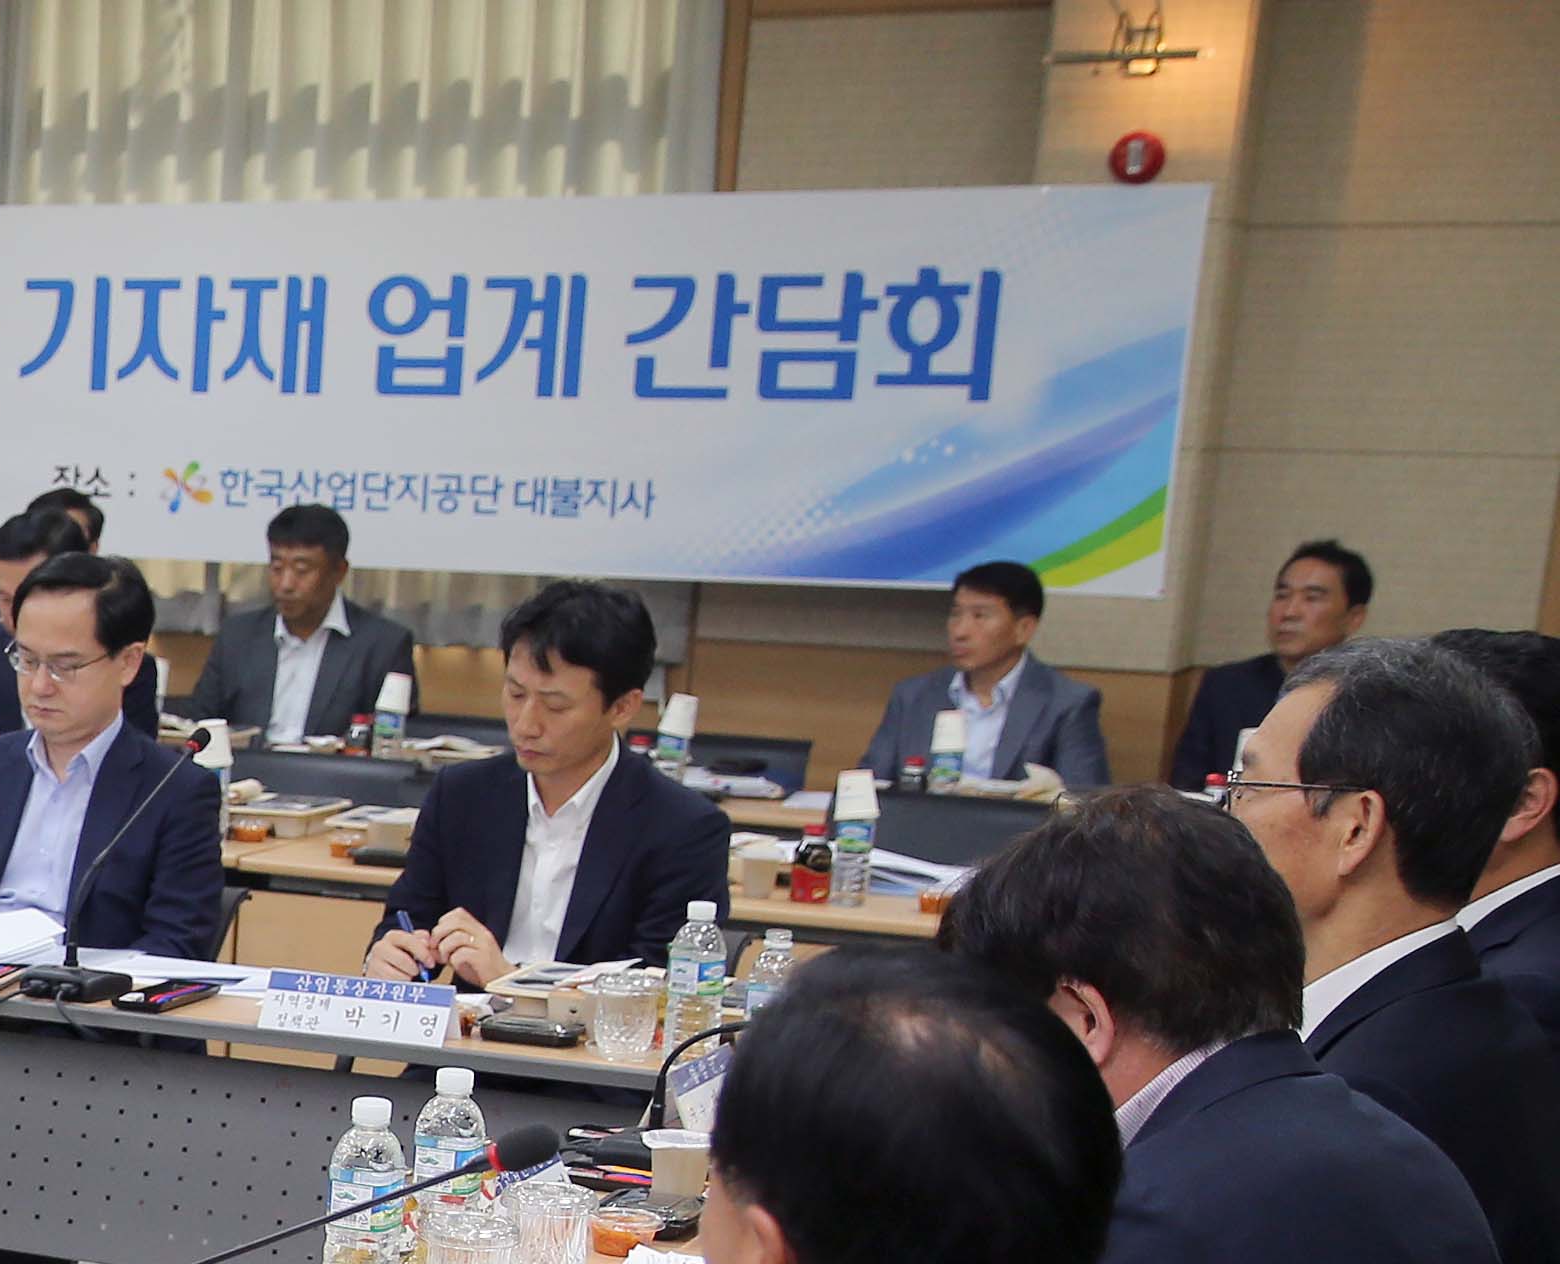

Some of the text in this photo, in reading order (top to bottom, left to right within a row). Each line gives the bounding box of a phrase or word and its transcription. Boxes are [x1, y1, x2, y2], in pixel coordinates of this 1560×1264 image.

[368, 274, 587, 398] 업계
[625, 266, 1002, 401] 간담회
[219, 466, 657, 519] 한국산업단지공단 대불지사
[295, 974, 427, 1003] 산업통상자원부
